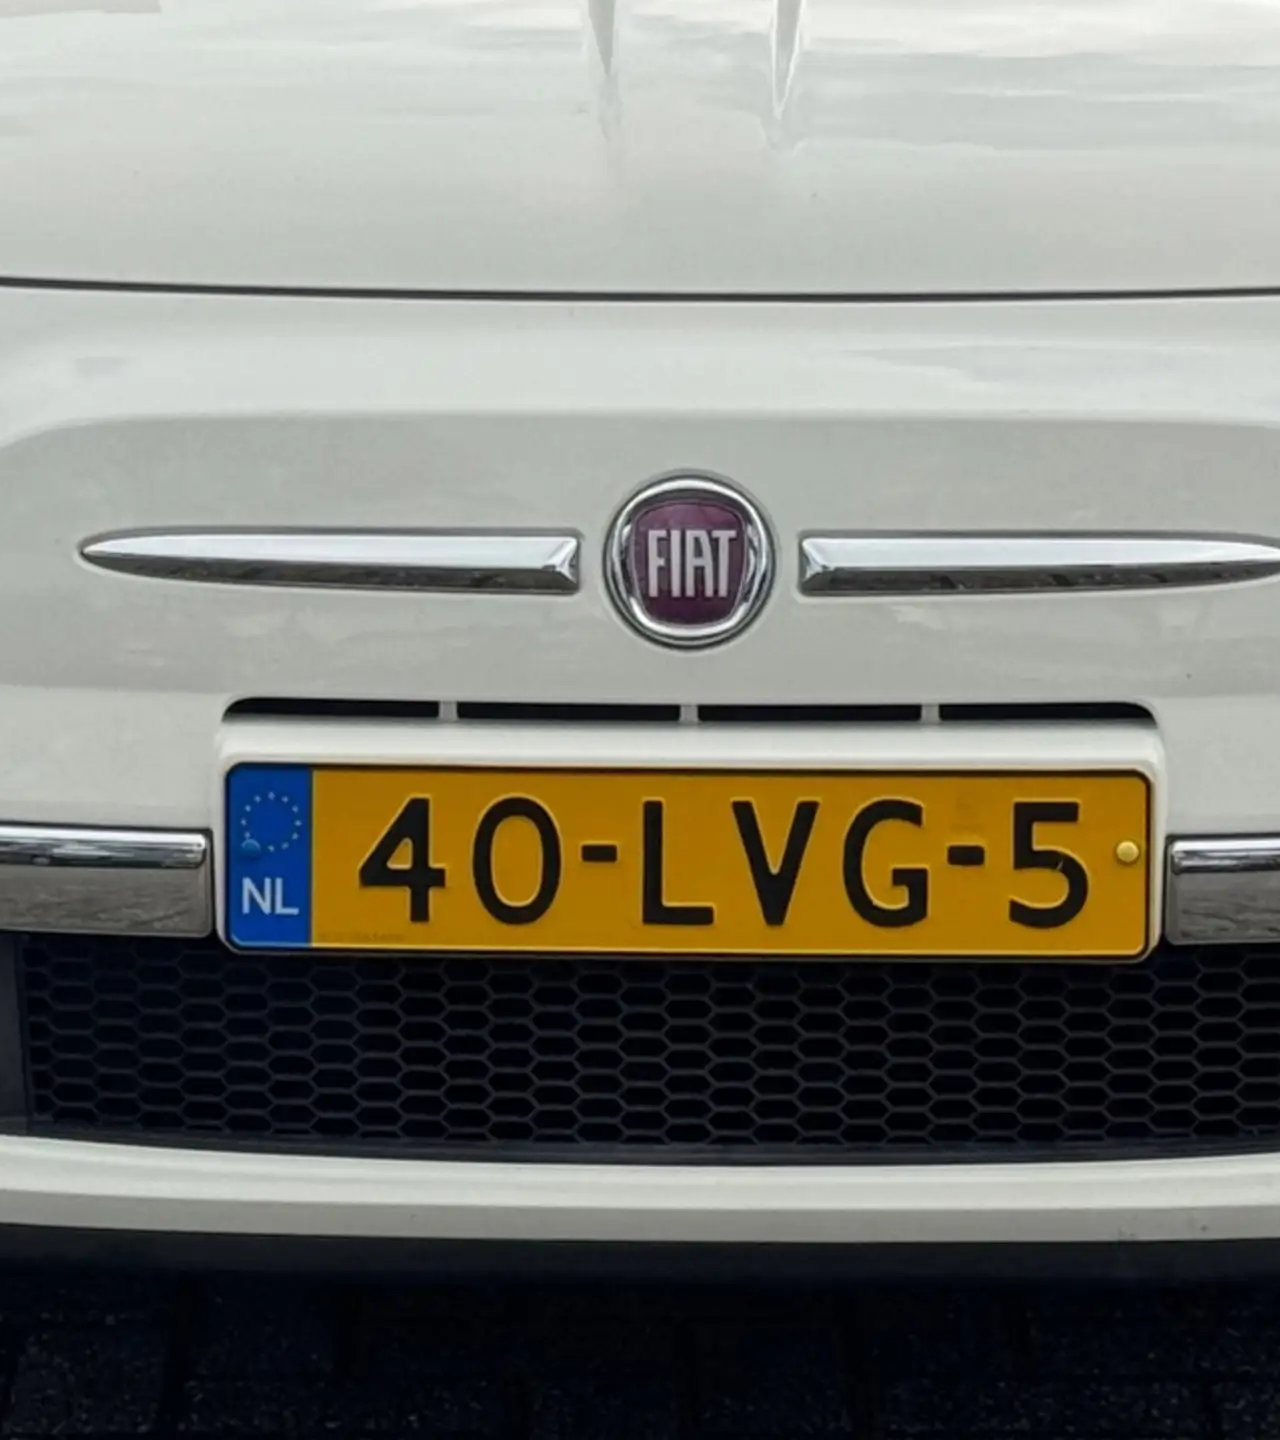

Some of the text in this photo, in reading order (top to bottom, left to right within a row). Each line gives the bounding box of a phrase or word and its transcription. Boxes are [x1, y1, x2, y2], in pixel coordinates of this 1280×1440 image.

[647, 528, 738, 599] FIAT
[242, 876, 300, 916] NL
[358, 796, 1090, 930] 40-LVG-5
